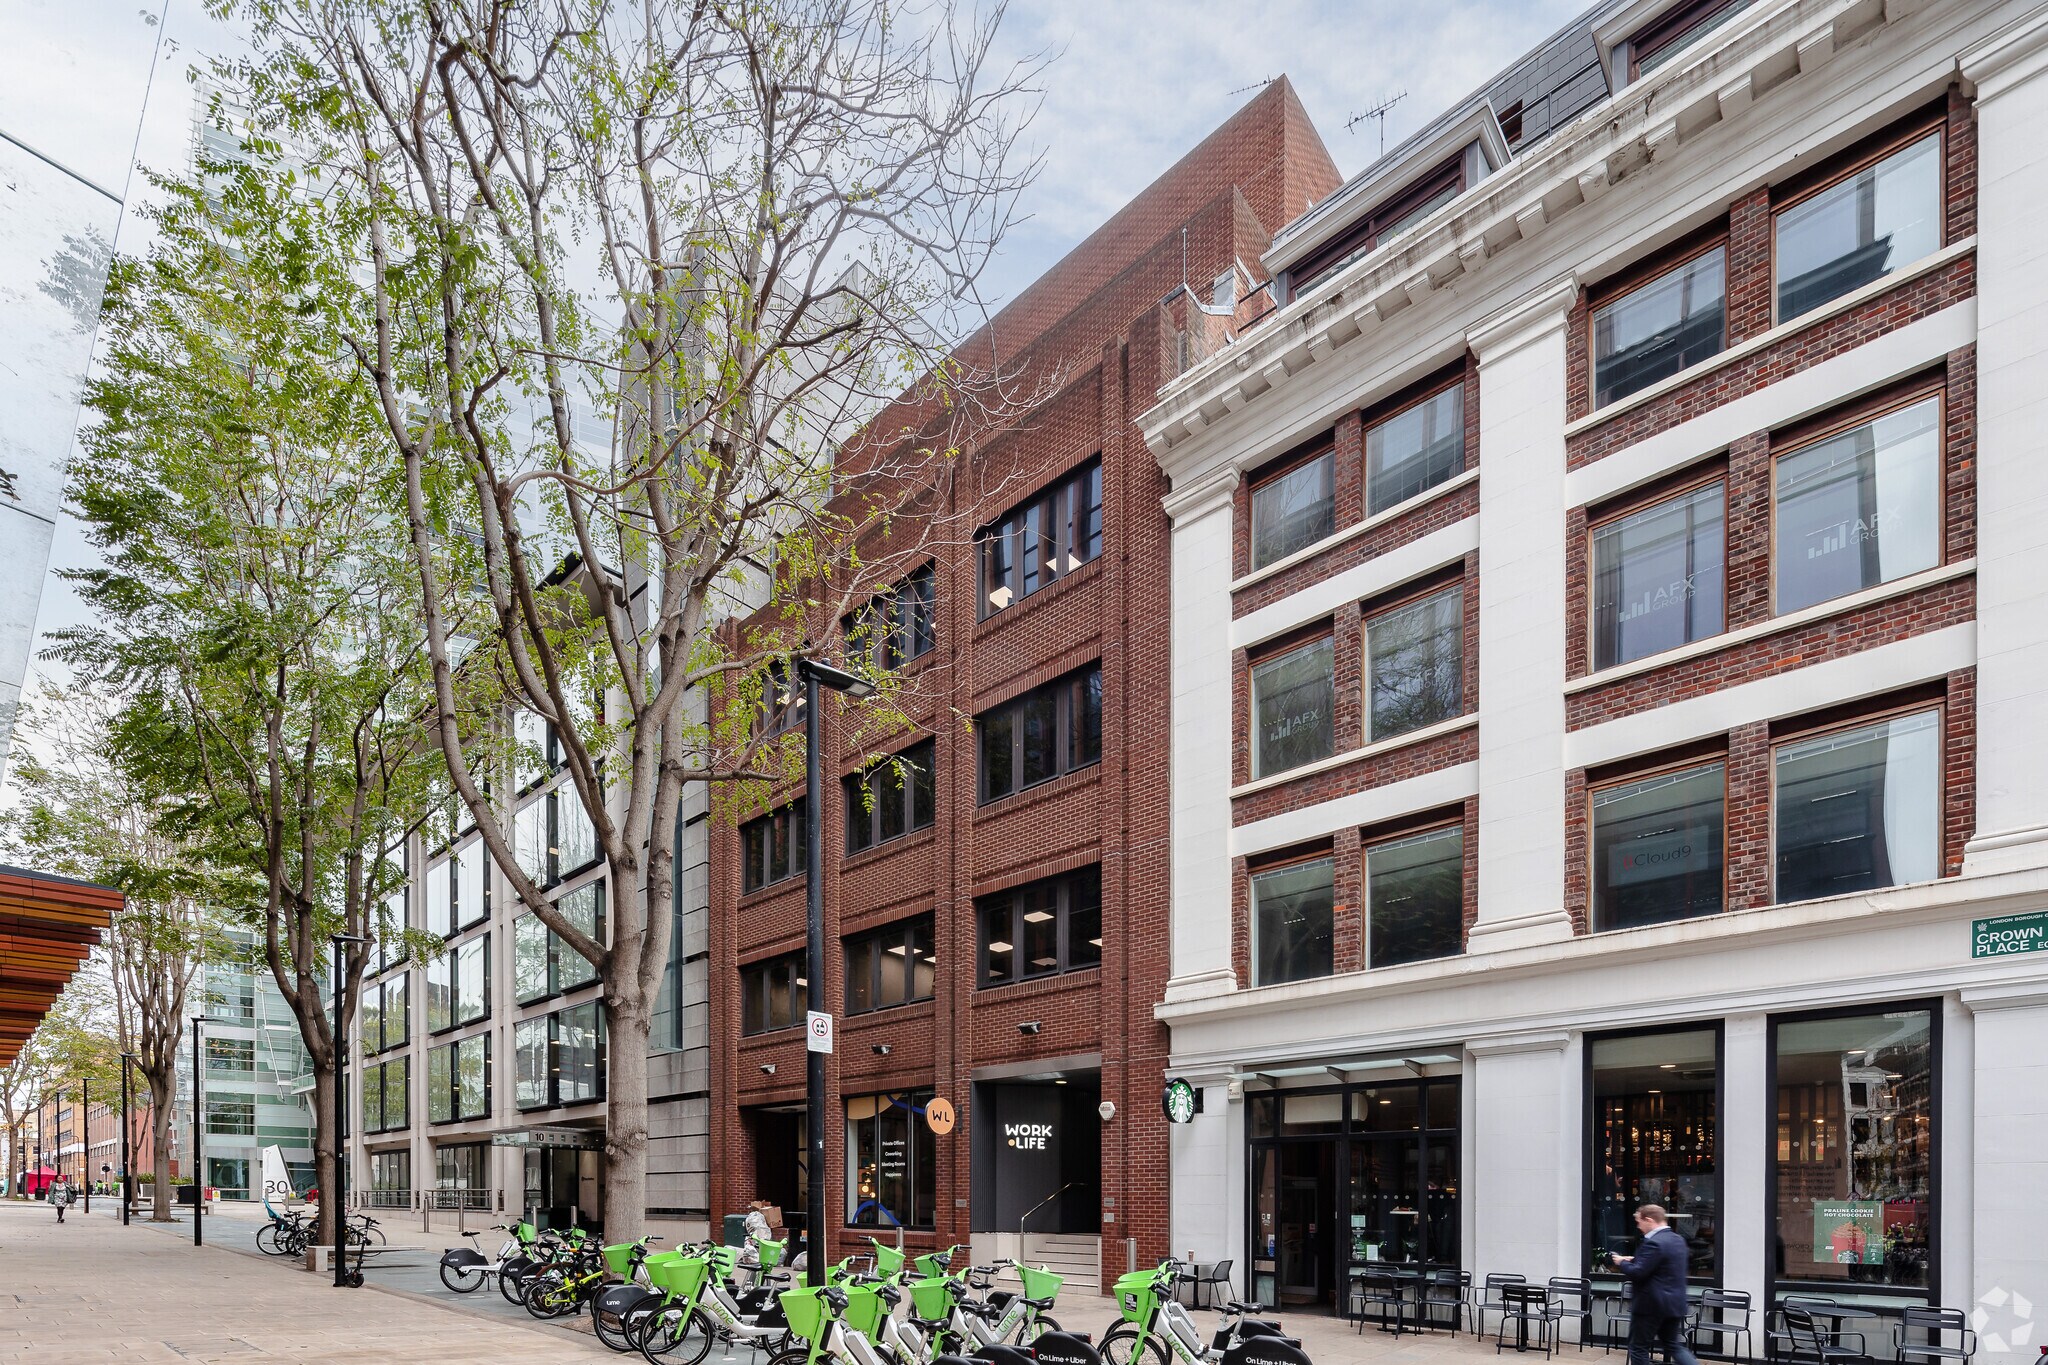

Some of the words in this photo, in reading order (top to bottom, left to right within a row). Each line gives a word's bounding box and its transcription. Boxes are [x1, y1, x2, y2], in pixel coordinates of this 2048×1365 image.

[1653, 576, 1695, 602] AFX
[1653, 590, 1696, 611] GROUP
[1292, 707, 1319, 728] AFX
[1634, 845, 1692, 866] Cloud9
[2014, 913, 2043, 922] BOROUGH
[1976, 926, 2043, 945] CROWN
[1976, 939, 2030, 956] PLACE
[535, 1132, 545, 1142] 10
[1004, 1123, 1053, 1137] WORK
[265, 1180, 288, 1194] 30
[712, 1301, 734, 1325] Lime
[998, 1309, 1019, 1333] Lime
[1166, 1333, 1191, 1363] Lime
[1039, 1353, 1049, 1361] On
[1048, 1354, 1064, 1363] Lime
[1069, 1356, 1087, 1365] Uber
[1245, 1356, 1256, 1364] On
